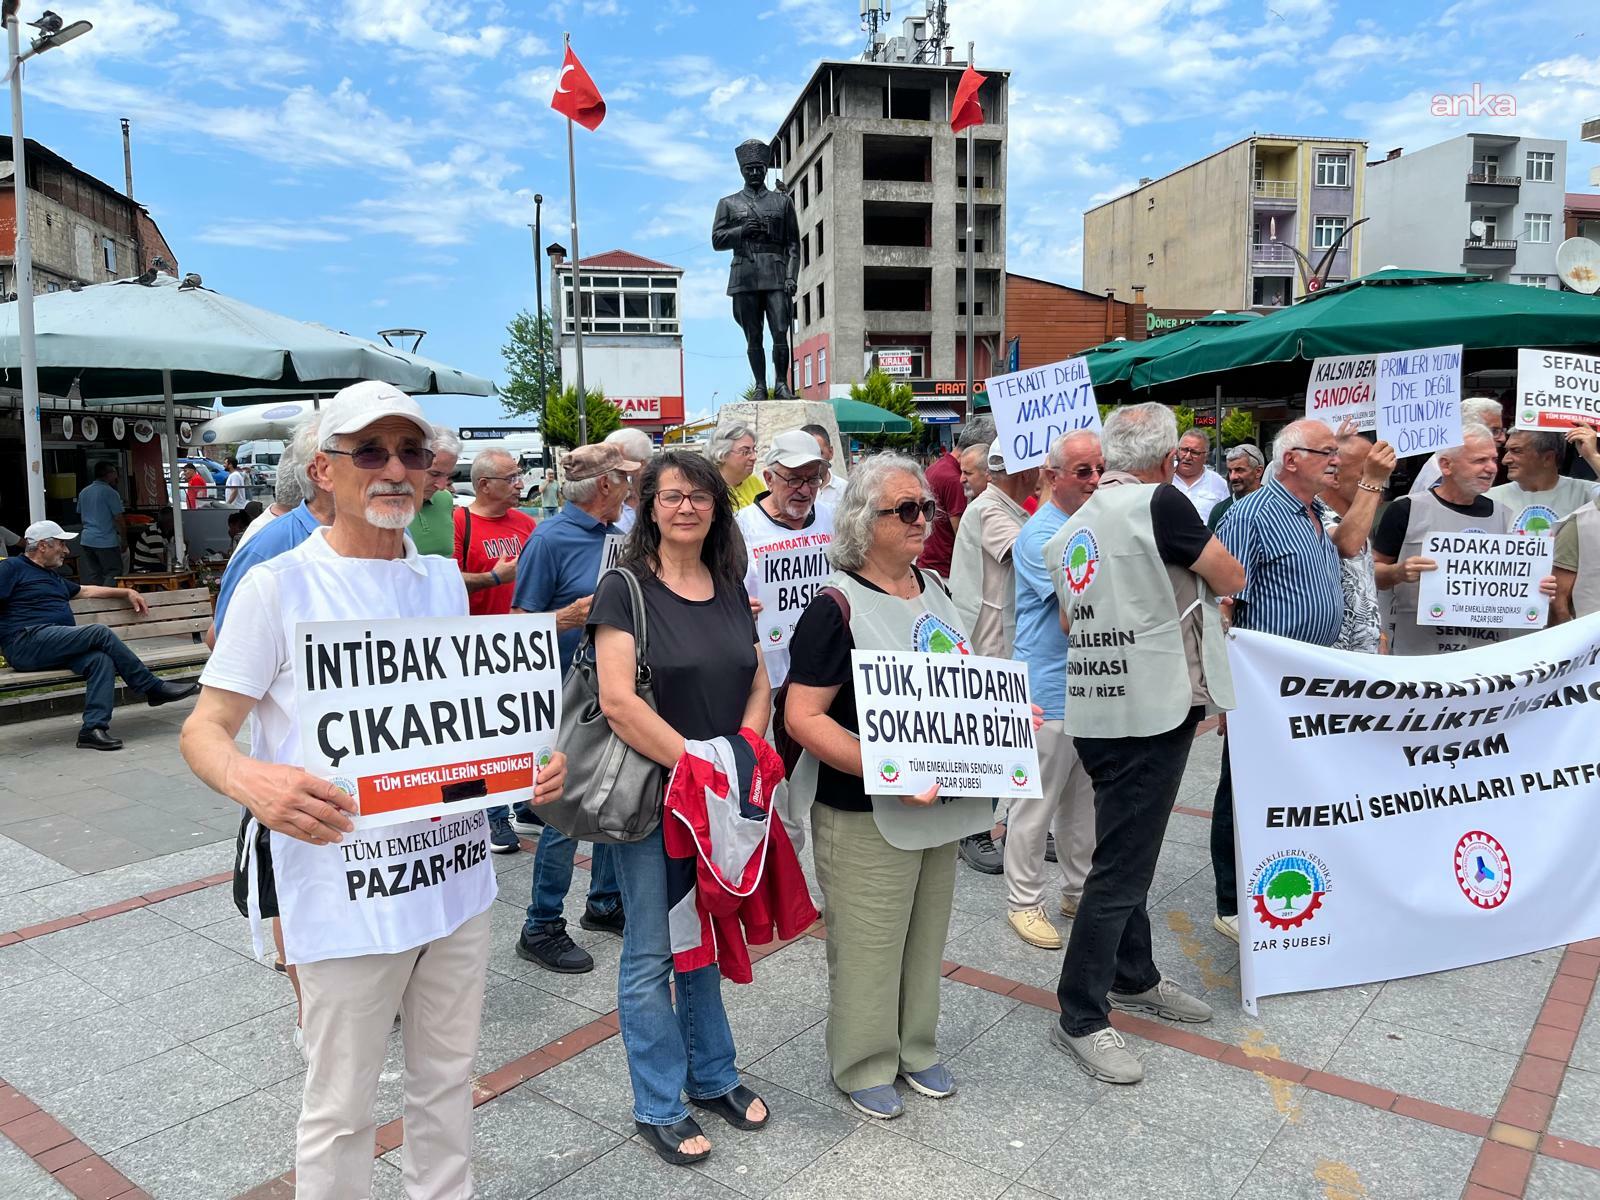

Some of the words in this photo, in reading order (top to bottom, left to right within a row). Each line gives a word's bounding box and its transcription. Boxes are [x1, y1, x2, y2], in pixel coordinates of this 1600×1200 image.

[879, 356, 911, 366] KIRALIK
[1316, 362, 1352, 382] KALSIN
[1355, 359, 1377, 378] BEN
[1432, 352, 1460, 371] YUTUN
[1543, 355, 1600, 375] SEFALE
[1054, 361, 1090, 386] DEĞİL
[1555, 375, 1600, 393] BOYU
[935, 383, 966, 394] FIRAT
[1314, 381, 1369, 410] SANDIĞA
[1391, 380, 1418, 401] DİYE
[1424, 374, 1455, 398] DEĞİL
[1016, 383, 1091, 424] NAKAVT
[1524, 390, 1600, 414] EĞMEYEC
[1430, 537, 1500, 554] SADAKA
[1505, 538, 1549, 557] DEĞİL
[765, 547, 830, 583] İKRAMİY
[1446, 559, 1531, 577] HAKKIMIZI
[778, 582, 820, 611] BAŞI
[1446, 577, 1529, 598] İSTİYORUZ
[1452, 603, 1464, 612] TÜM
[1465, 605, 1496, 613] EMEKLİLERİN
[305, 631, 447, 691] İNTİBAK
[451, 630, 556, 677] YASASI
[1280, 673, 1516, 699] DEMOKRATİK
[1516, 644, 1600, 687] TÜRKİY
[859, 655, 922, 701] TÜİK,
[925, 657, 1027, 704] İKTİDARIN
[1096, 683, 1126, 698] RİZE
[317, 689, 556, 768] ÇIKARILSIN
[865, 709, 979, 745] SOKAKLAR
[983, 706, 1033, 748] BİZİM
[1288, 705, 1504, 740] EMEKLİLİKTE
[1402, 733, 1510, 769] YAŞAM
[373, 778, 402, 793] TÜM
[403, 766, 478, 789] EMEKLİLERİN
[480, 756, 532, 776] SENDİKASI
[909, 758, 925, 772] TÜM
[927, 759, 970, 773] EMEKLİLERİN
[971, 761, 1004, 774] SENDİKASI
[936, 776, 958, 788] PAZAR
[959, 776, 982, 791] ŞUBESİ
[1266, 794, 1365, 828] EMEKLİ
[1370, 776, 1516, 819] SENDİKALARI
[1520, 762, 1600, 794] PLATFO
[341, 839, 382, 862] TÜM
[1283, 934, 1332, 951] ŞUBESİ
